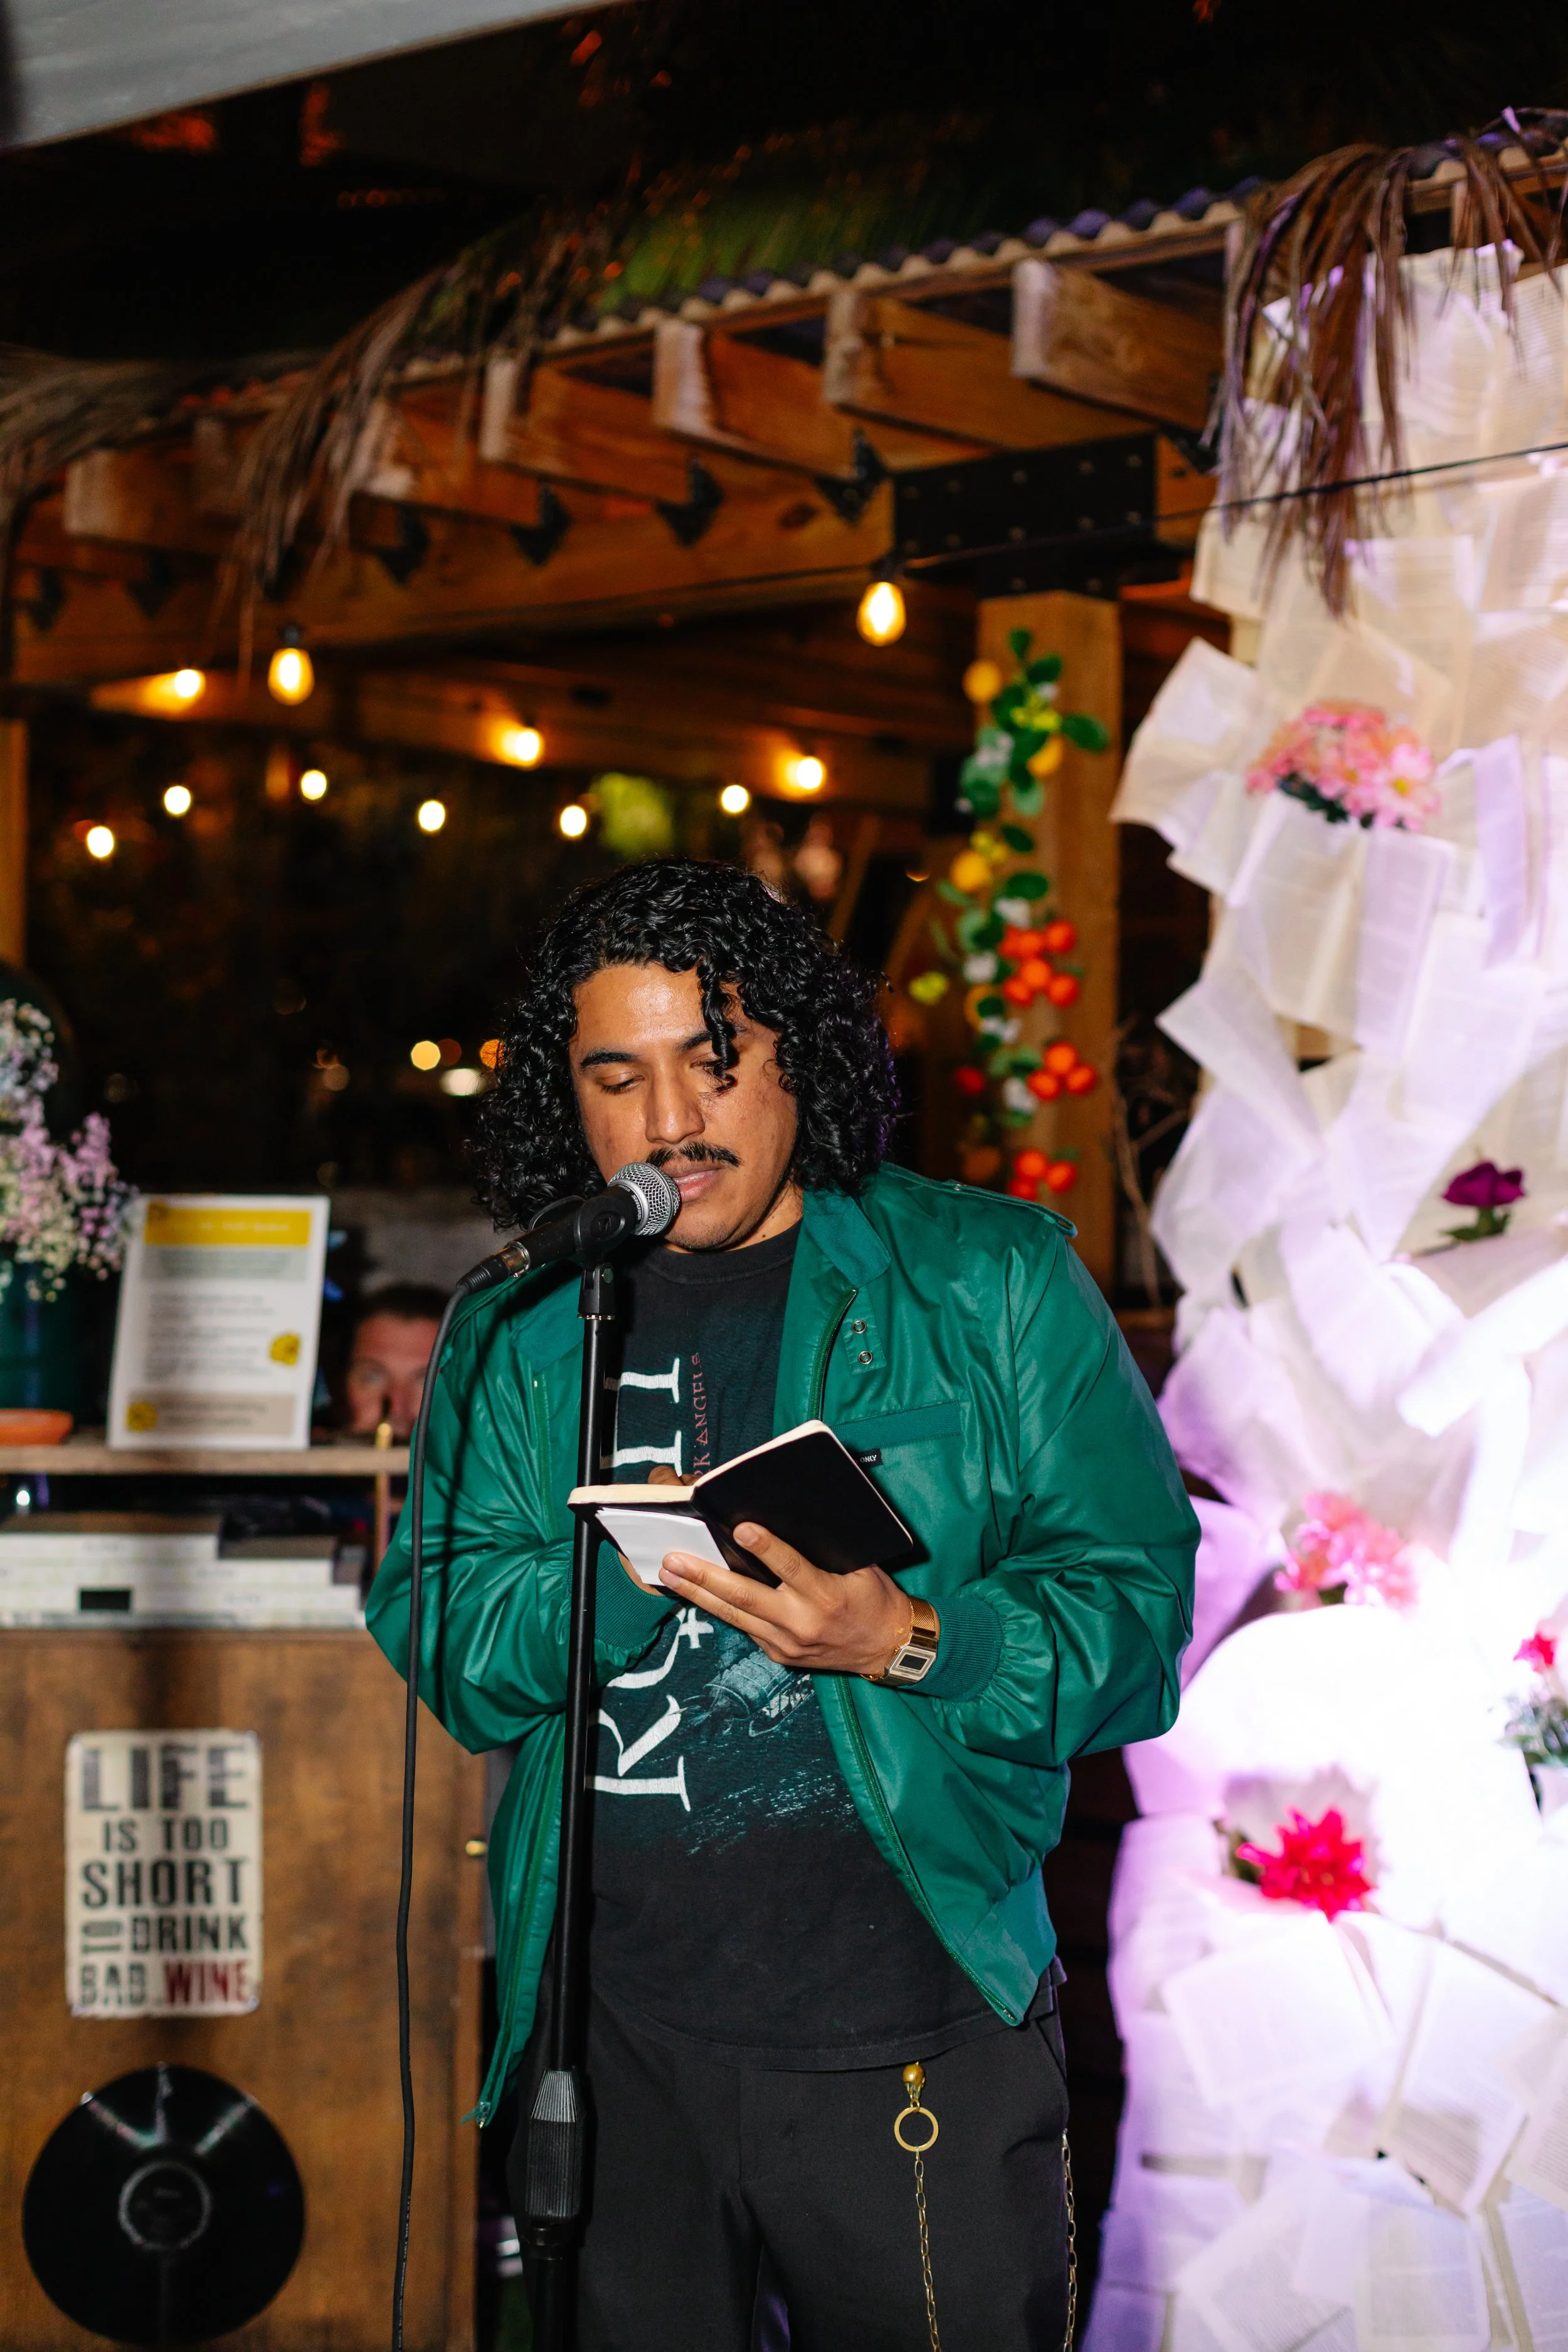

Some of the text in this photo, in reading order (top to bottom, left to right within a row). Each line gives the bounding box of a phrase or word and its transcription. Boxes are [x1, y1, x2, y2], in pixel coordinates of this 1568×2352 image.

[631, 1194, 642, 1221] SHURE
[860, 1454, 877, 1463] ONLY
[82, 1745, 249, 1811] LIFE
[104, 1816, 228, 1852] IS TOO
[82, 1857, 248, 1909] SHORT
[131, 1914, 247, 1953] DRINK
[80, 1957, 248, 2005] BAD WINE
